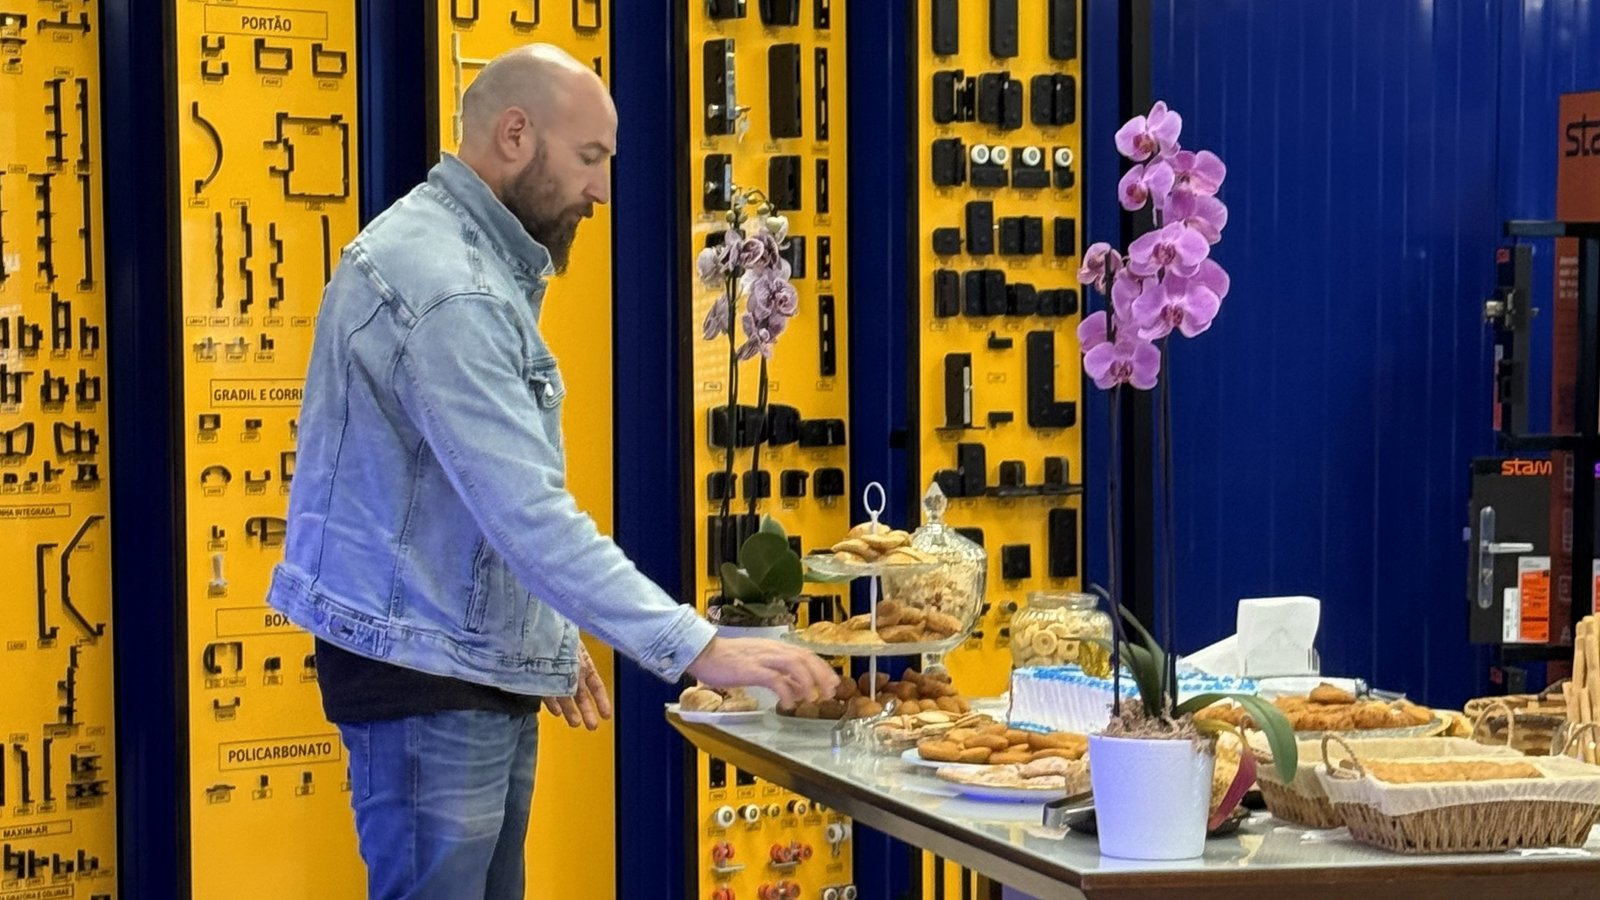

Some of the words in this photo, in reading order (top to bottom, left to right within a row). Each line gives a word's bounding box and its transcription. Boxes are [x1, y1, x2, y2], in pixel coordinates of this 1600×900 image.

[241, 15, 292, 32] PORTÃO
[213, 388, 257, 401] GRADIL
[260, 388, 267, 401] E
[1502, 459, 1552, 475] stam
[15, 507, 56, 516] INTEGRADA
[264, 613, 290, 627] BOX
[228, 742, 332, 763] POLICARBONATO
[3, 824, 48, 838] MAXIM-AR
